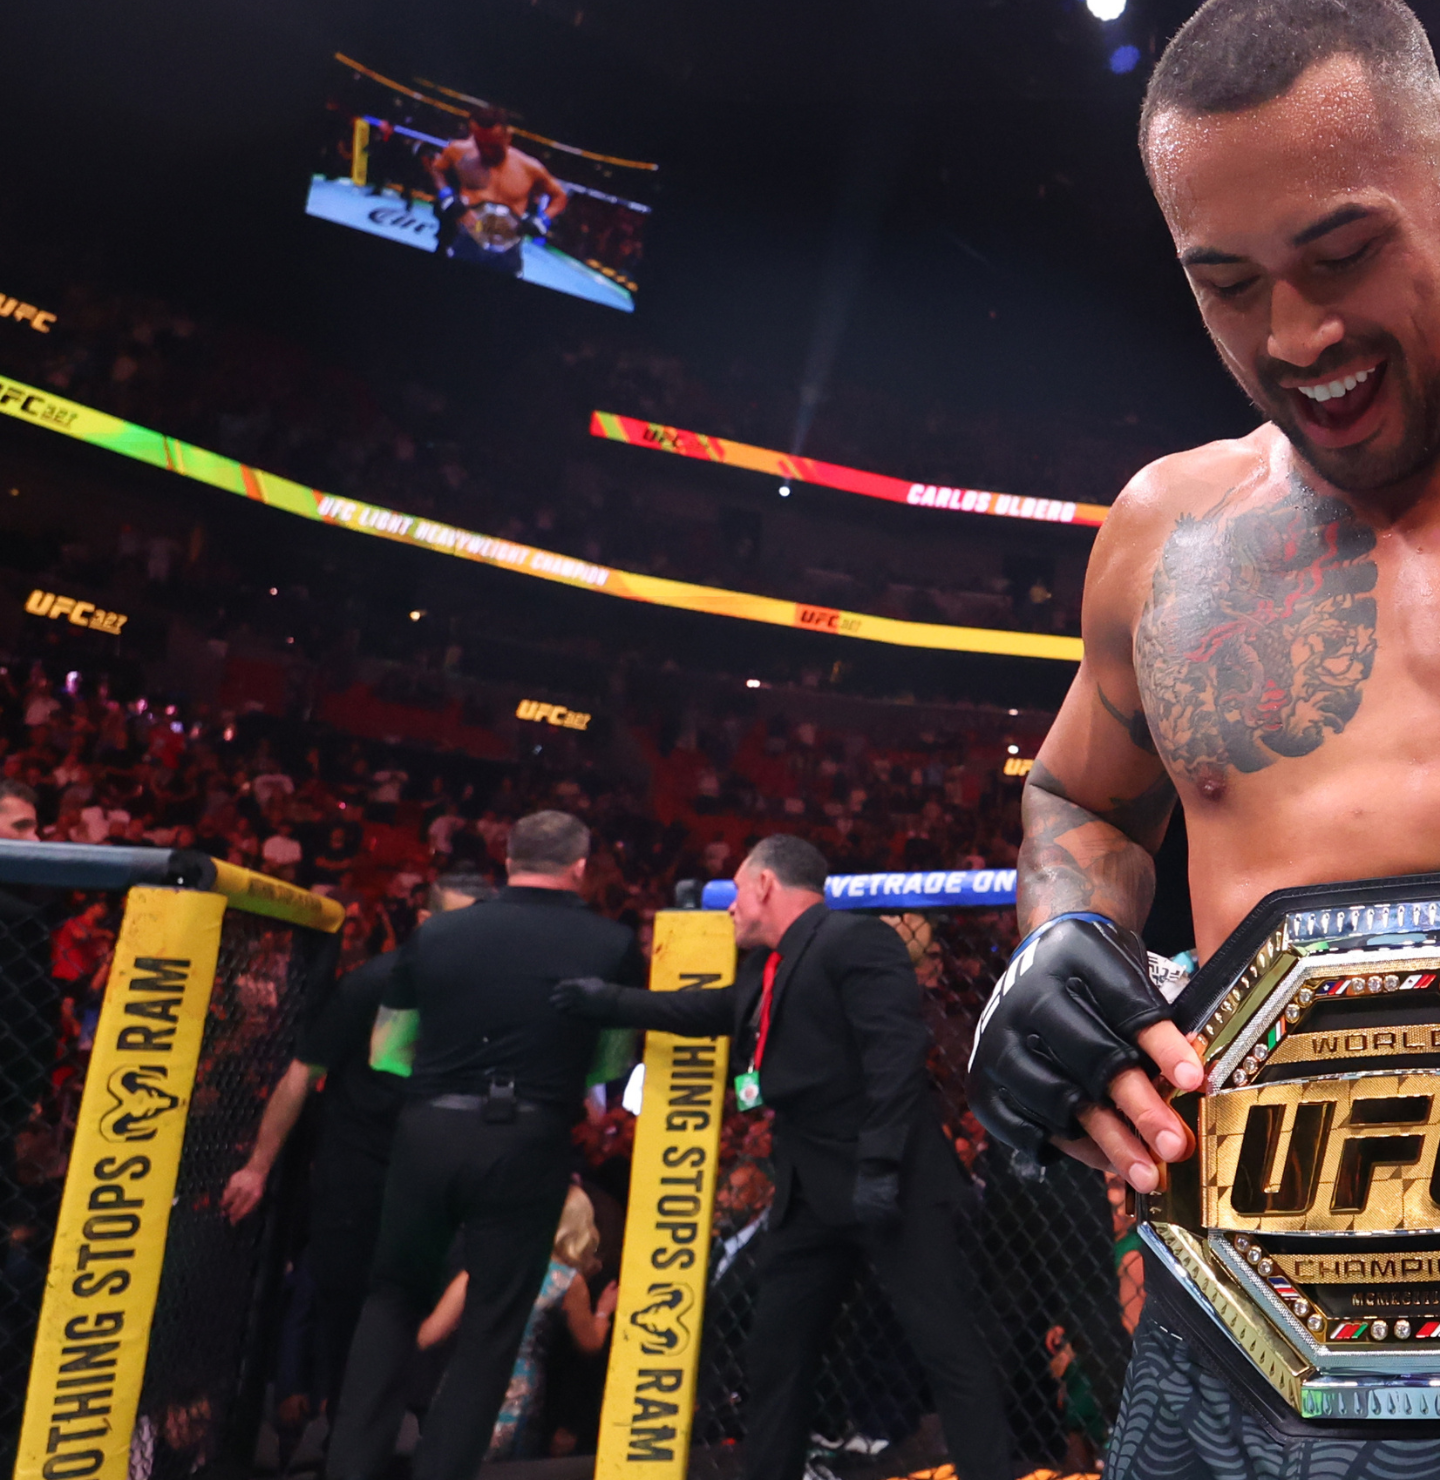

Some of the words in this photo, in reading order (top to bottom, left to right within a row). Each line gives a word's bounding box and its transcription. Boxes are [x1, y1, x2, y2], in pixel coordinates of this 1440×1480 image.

[0, 293, 57, 333] UFC
[907, 483, 992, 513] CARLOS
[994, 493, 1077, 523] ULBERG
[318, 496, 356, 522] UFC
[358, 507, 414, 535] LIGHT
[414, 522, 531, 565] HEAVYWEIGHT
[529, 553, 608, 586] CHAMPION
[25, 589, 95, 627] UFC
[801, 610, 839, 628] UFC
[515, 699, 568, 726] UFC
[824, 872, 967, 898] VETRADE
[665, 973, 722, 1132] NHING
[72, 1155, 152, 1298] STOPS
[116, 956, 192, 1051] RAM
[650, 1146, 706, 1270] STOPS
[626, 1368, 684, 1462] RAM
